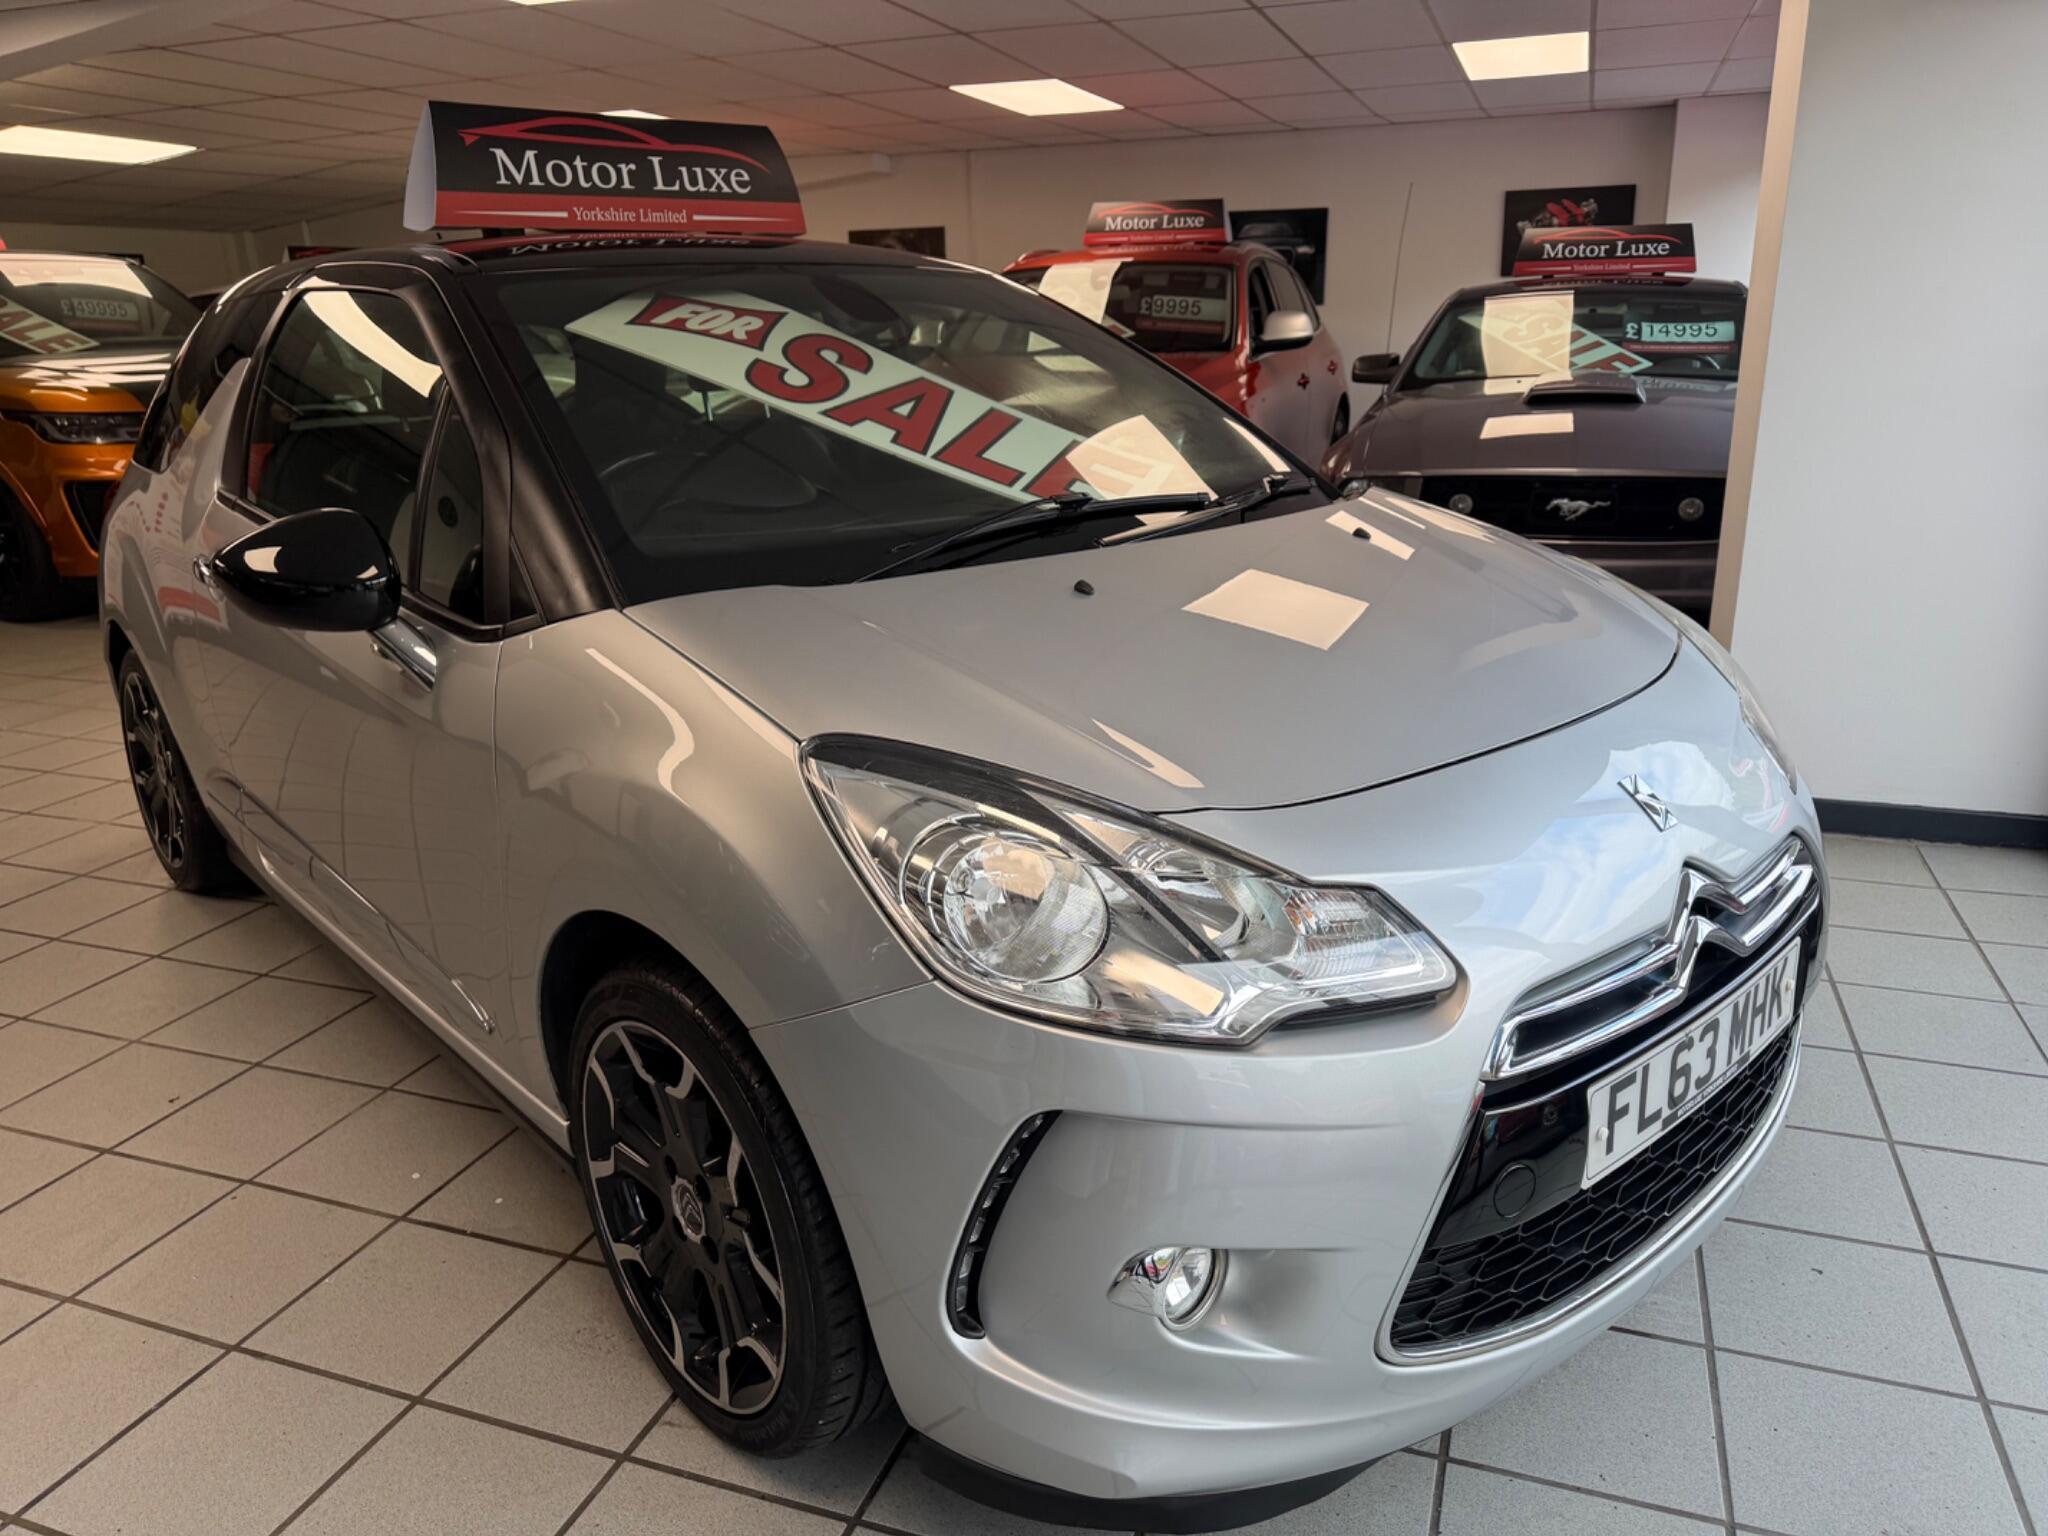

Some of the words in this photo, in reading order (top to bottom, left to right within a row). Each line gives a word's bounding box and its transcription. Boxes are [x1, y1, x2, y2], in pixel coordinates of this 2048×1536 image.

[489, 147, 637, 190] Motor
[647, 155, 752, 194] Luxe
[573, 206, 636, 222] Yorkshire
[639, 207, 688, 223] Limited
[1104, 214, 1158, 231] Motor
[1162, 212, 1205, 229] Luxe
[1541, 242, 1610, 259] Motor
[1615, 240, 1670, 257] Luxe
[651, 300, 773, 341] FOR
[1606, 1018, 1720, 1155] FL63
[1727, 956, 1788, 1066] MHK
